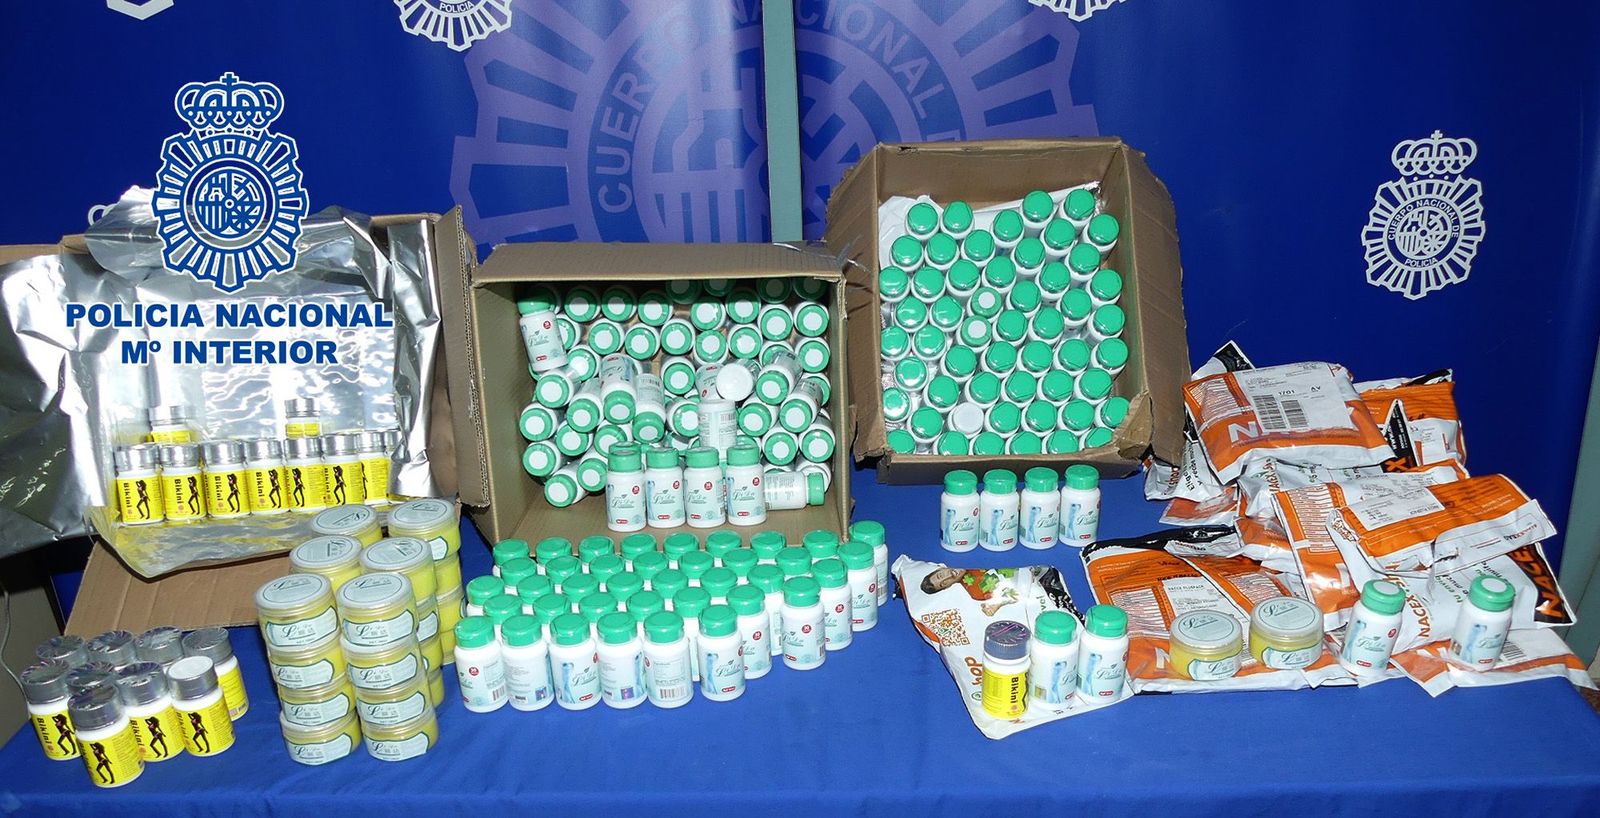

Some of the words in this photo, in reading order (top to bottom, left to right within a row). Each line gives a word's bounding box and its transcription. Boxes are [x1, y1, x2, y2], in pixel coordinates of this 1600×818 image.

[439, 1, 475, 14] POLICIA
[1387, 203, 1414, 241] CUERPO
[1416, 199, 1459, 229] NACIONAL
[1404, 257, 1438, 268] POLICIA
[123, 481, 131, 508] Bikini
[174, 478, 183, 504] Bikini
[214, 475, 222, 501] Bikini
[255, 471, 263, 497] Bikini
[1010, 676, 1019, 704] Bikini
[36, 717, 50, 745] Bikini
[130, 719, 144, 748] Bikini
